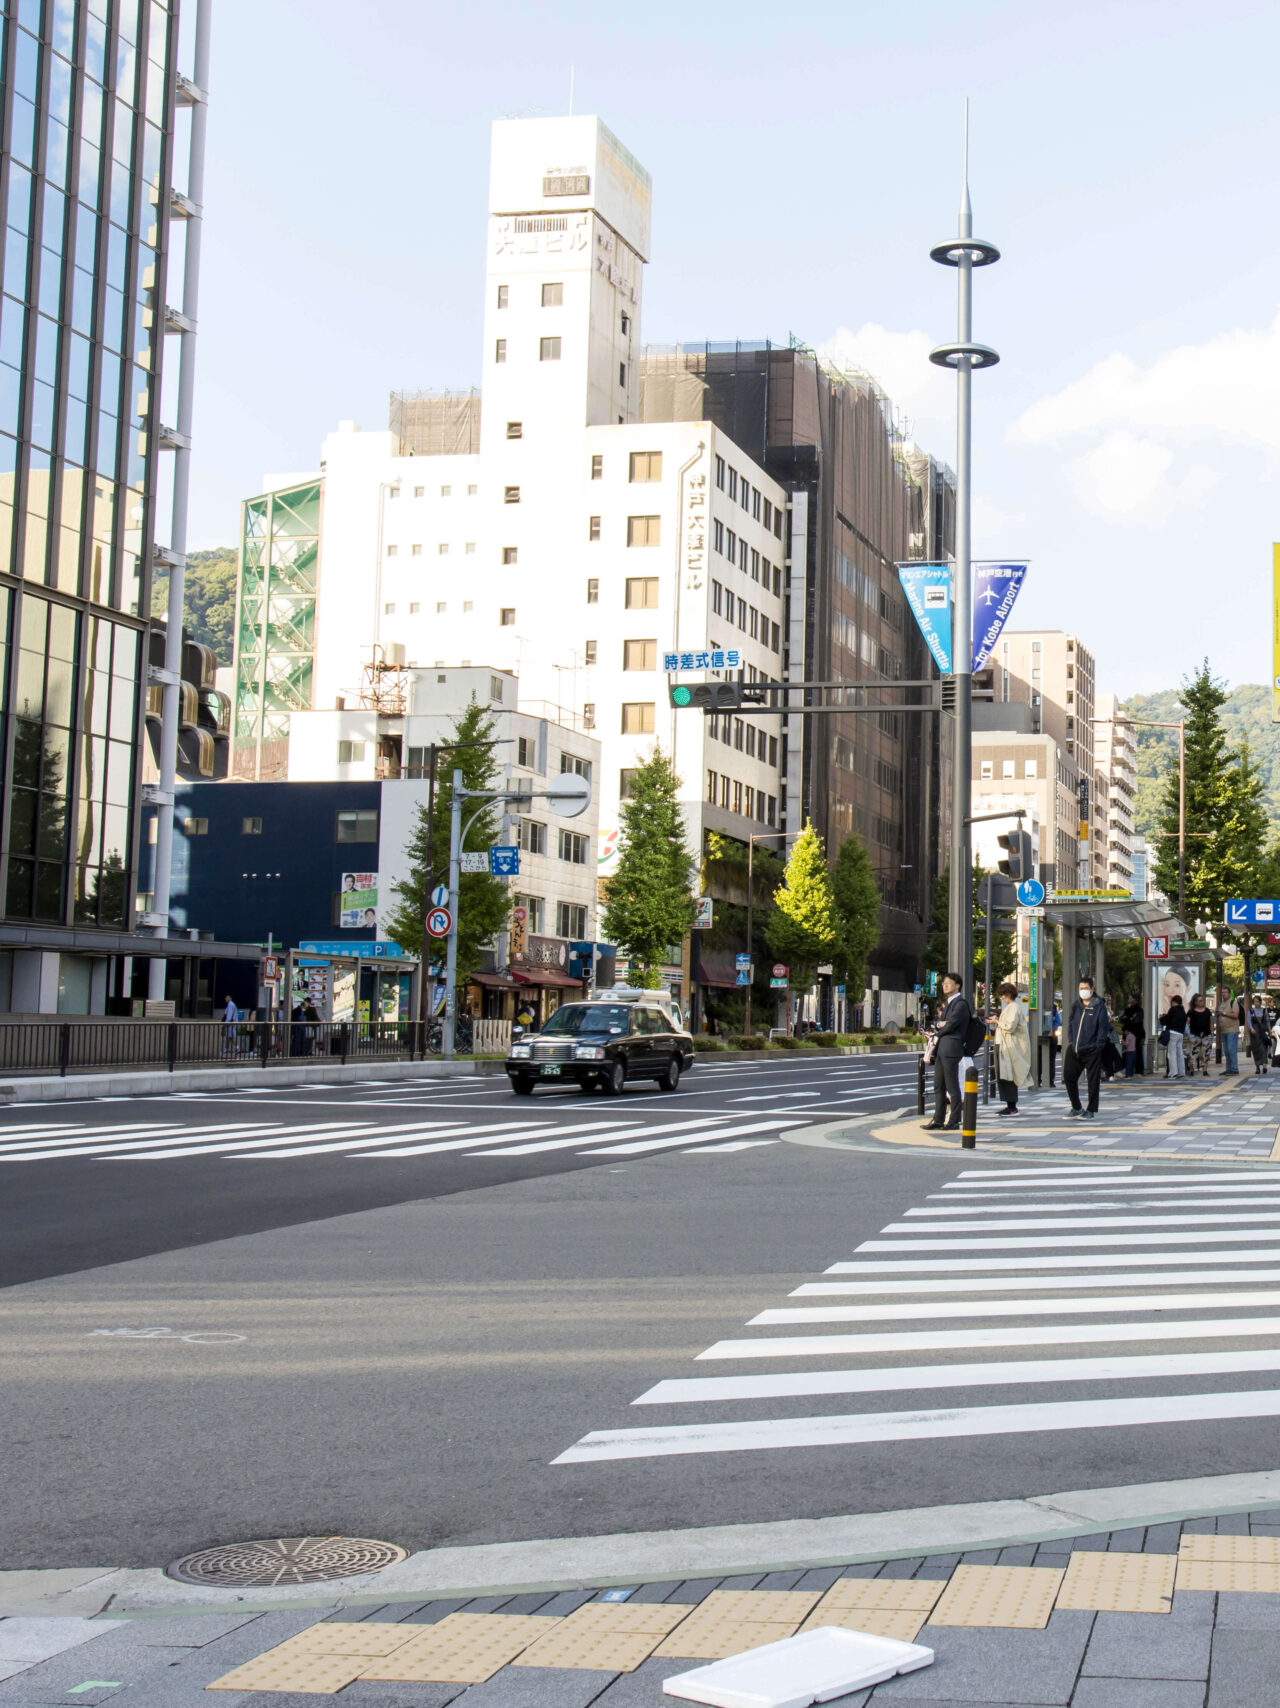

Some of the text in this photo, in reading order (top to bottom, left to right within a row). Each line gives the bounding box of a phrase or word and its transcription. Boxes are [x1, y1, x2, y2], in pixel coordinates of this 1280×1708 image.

[904, 581, 950, 670] Marine Air Shuttle
[975, 581, 1020, 664] for Kobe Airport
[664, 650, 740, 671] 時差式信号
[374, 945, 383, 956] P
[543, 1067, 561, 1076] 25-65
